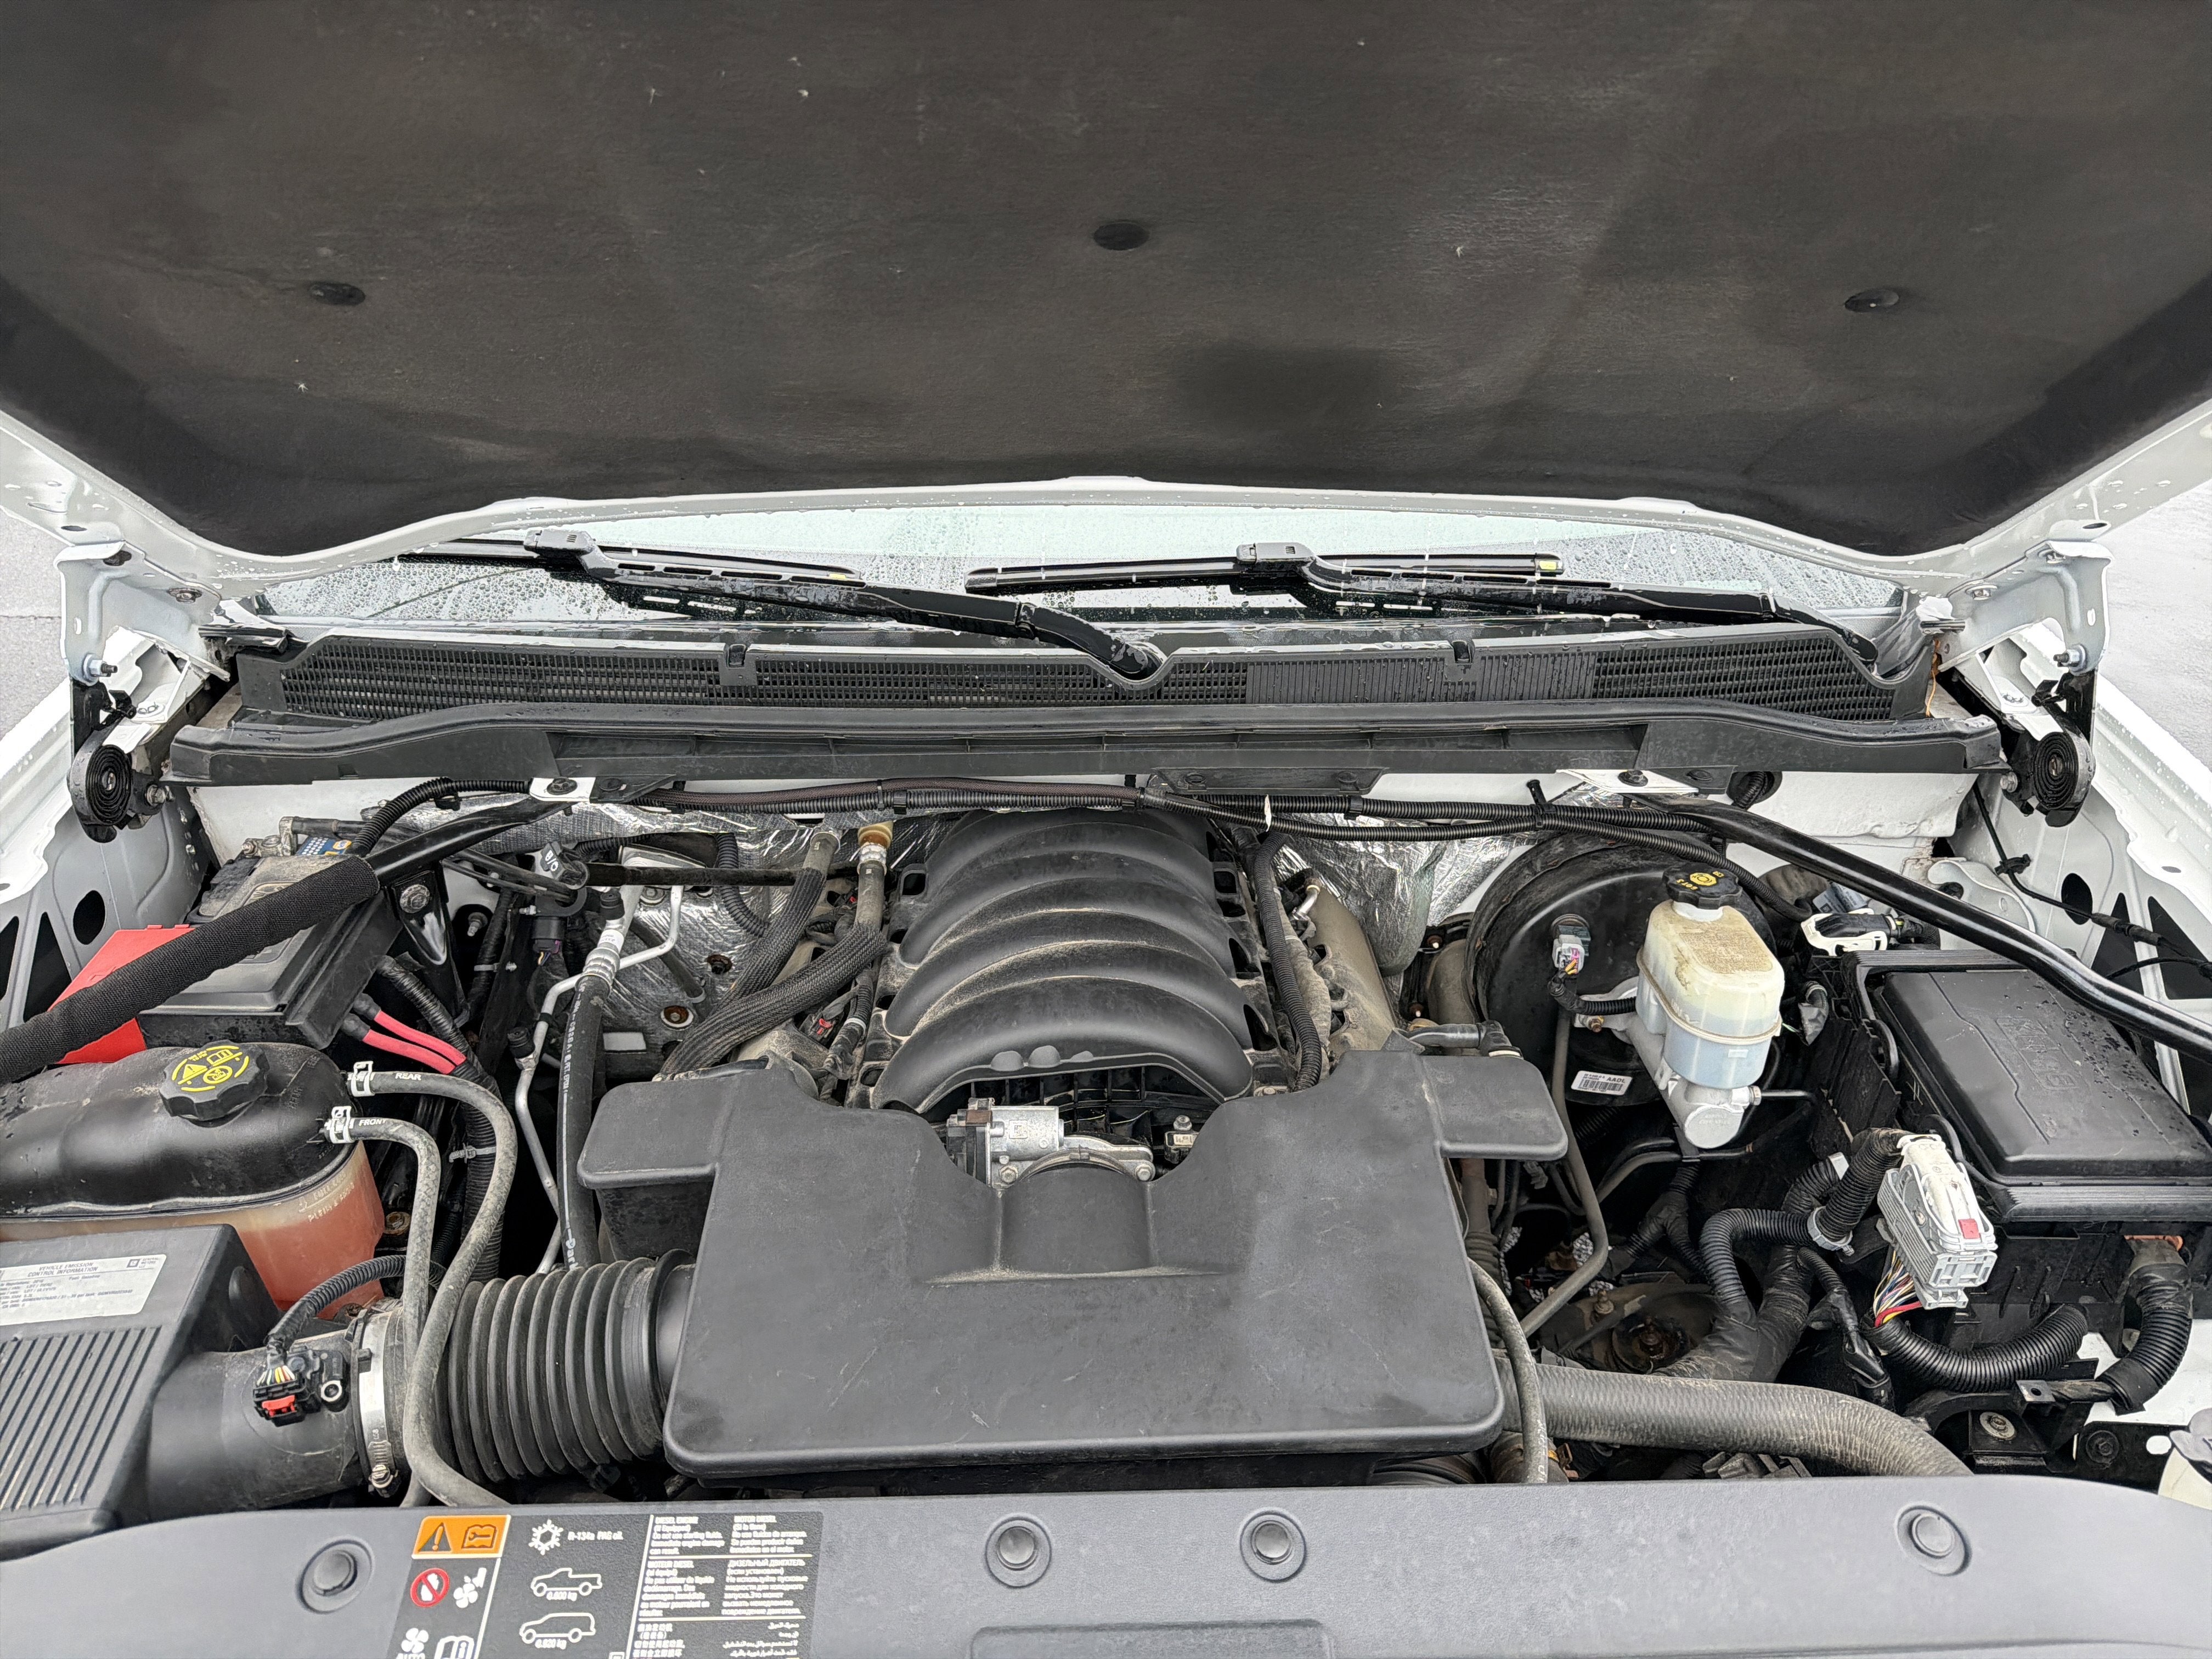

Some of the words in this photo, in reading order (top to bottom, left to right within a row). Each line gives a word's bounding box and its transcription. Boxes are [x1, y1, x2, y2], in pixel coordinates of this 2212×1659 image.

[395, 1073, 422, 1081] REAR
[567, 1592, 577, 1602] kg
[556, 1639, 567, 1650] kg
